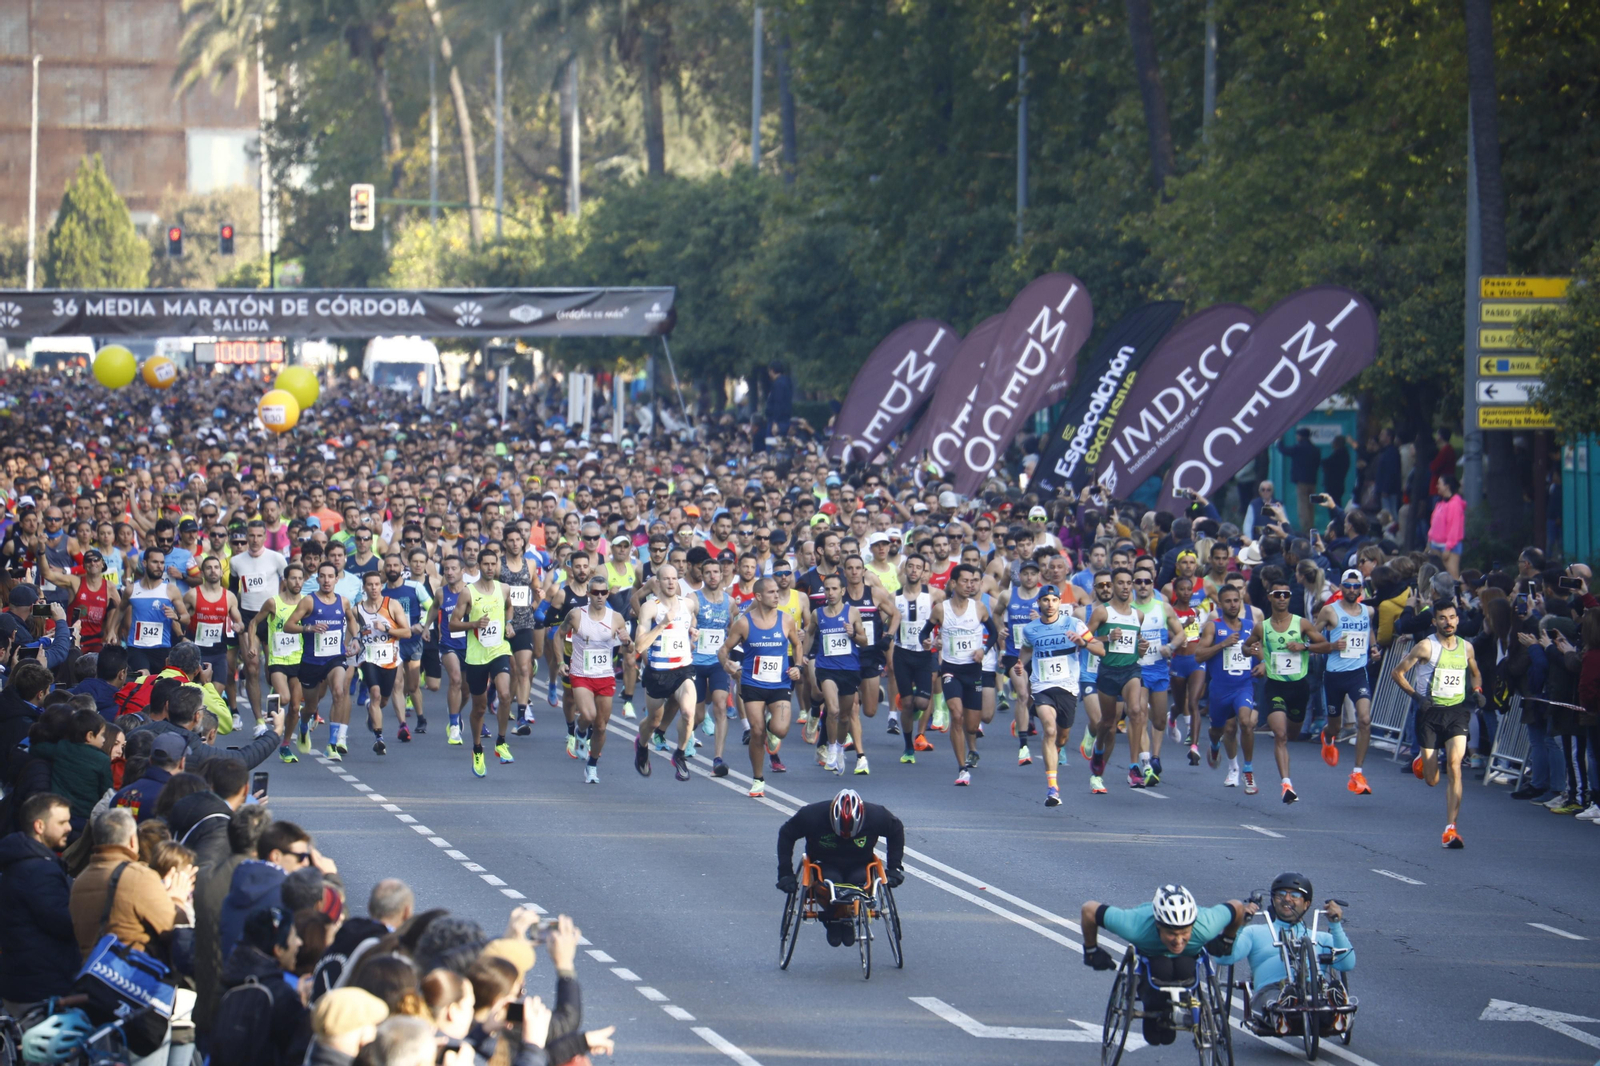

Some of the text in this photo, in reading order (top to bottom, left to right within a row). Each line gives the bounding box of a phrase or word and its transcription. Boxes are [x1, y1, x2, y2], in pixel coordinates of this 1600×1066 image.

[52, 295, 425, 316] 36 MEDIA MARATÓN DE CÓRDOBA
[1485, 309, 1510, 317] PASEO
[213, 318, 270, 332] SALIDA
[964, 283, 1079, 473] IMDECO
[842, 327, 946, 465] IMDEC
[1054, 345, 1136, 478] Especolchón
[1084, 371, 1138, 465] exclusive
[1482, 418, 1512, 426] Parking
[1127, 446, 1157, 474] Instituto
[1155, 414, 1190, 449] Municipal
[248, 578, 263, 587] 260
[511, 591, 525, 600] 410
[143, 626, 159, 636] 342
[481, 626, 497, 636] 242
[1342, 621, 1368, 631] nerja
[205, 629, 219, 637] 132
[280, 637, 295, 646] 434
[324, 636, 338, 645] 128
[709, 635, 720, 644] 72
[831, 638, 847, 648] 349
[1034, 637, 1066, 648] ALCALA
[1118, 635, 1133, 645] 454
[1350, 637, 1365, 647] 131
[673, 641, 683, 650] 64
[956, 641, 972, 650] 161
[1146, 646, 1157, 654] 44
[376, 649, 387, 658] 14
[592, 654, 607, 664] 133
[1285, 658, 1292, 668] 2
[762, 661, 778, 671] 350
[1050, 664, 1062, 673] 15
[1443, 675, 1460, 686] 325
